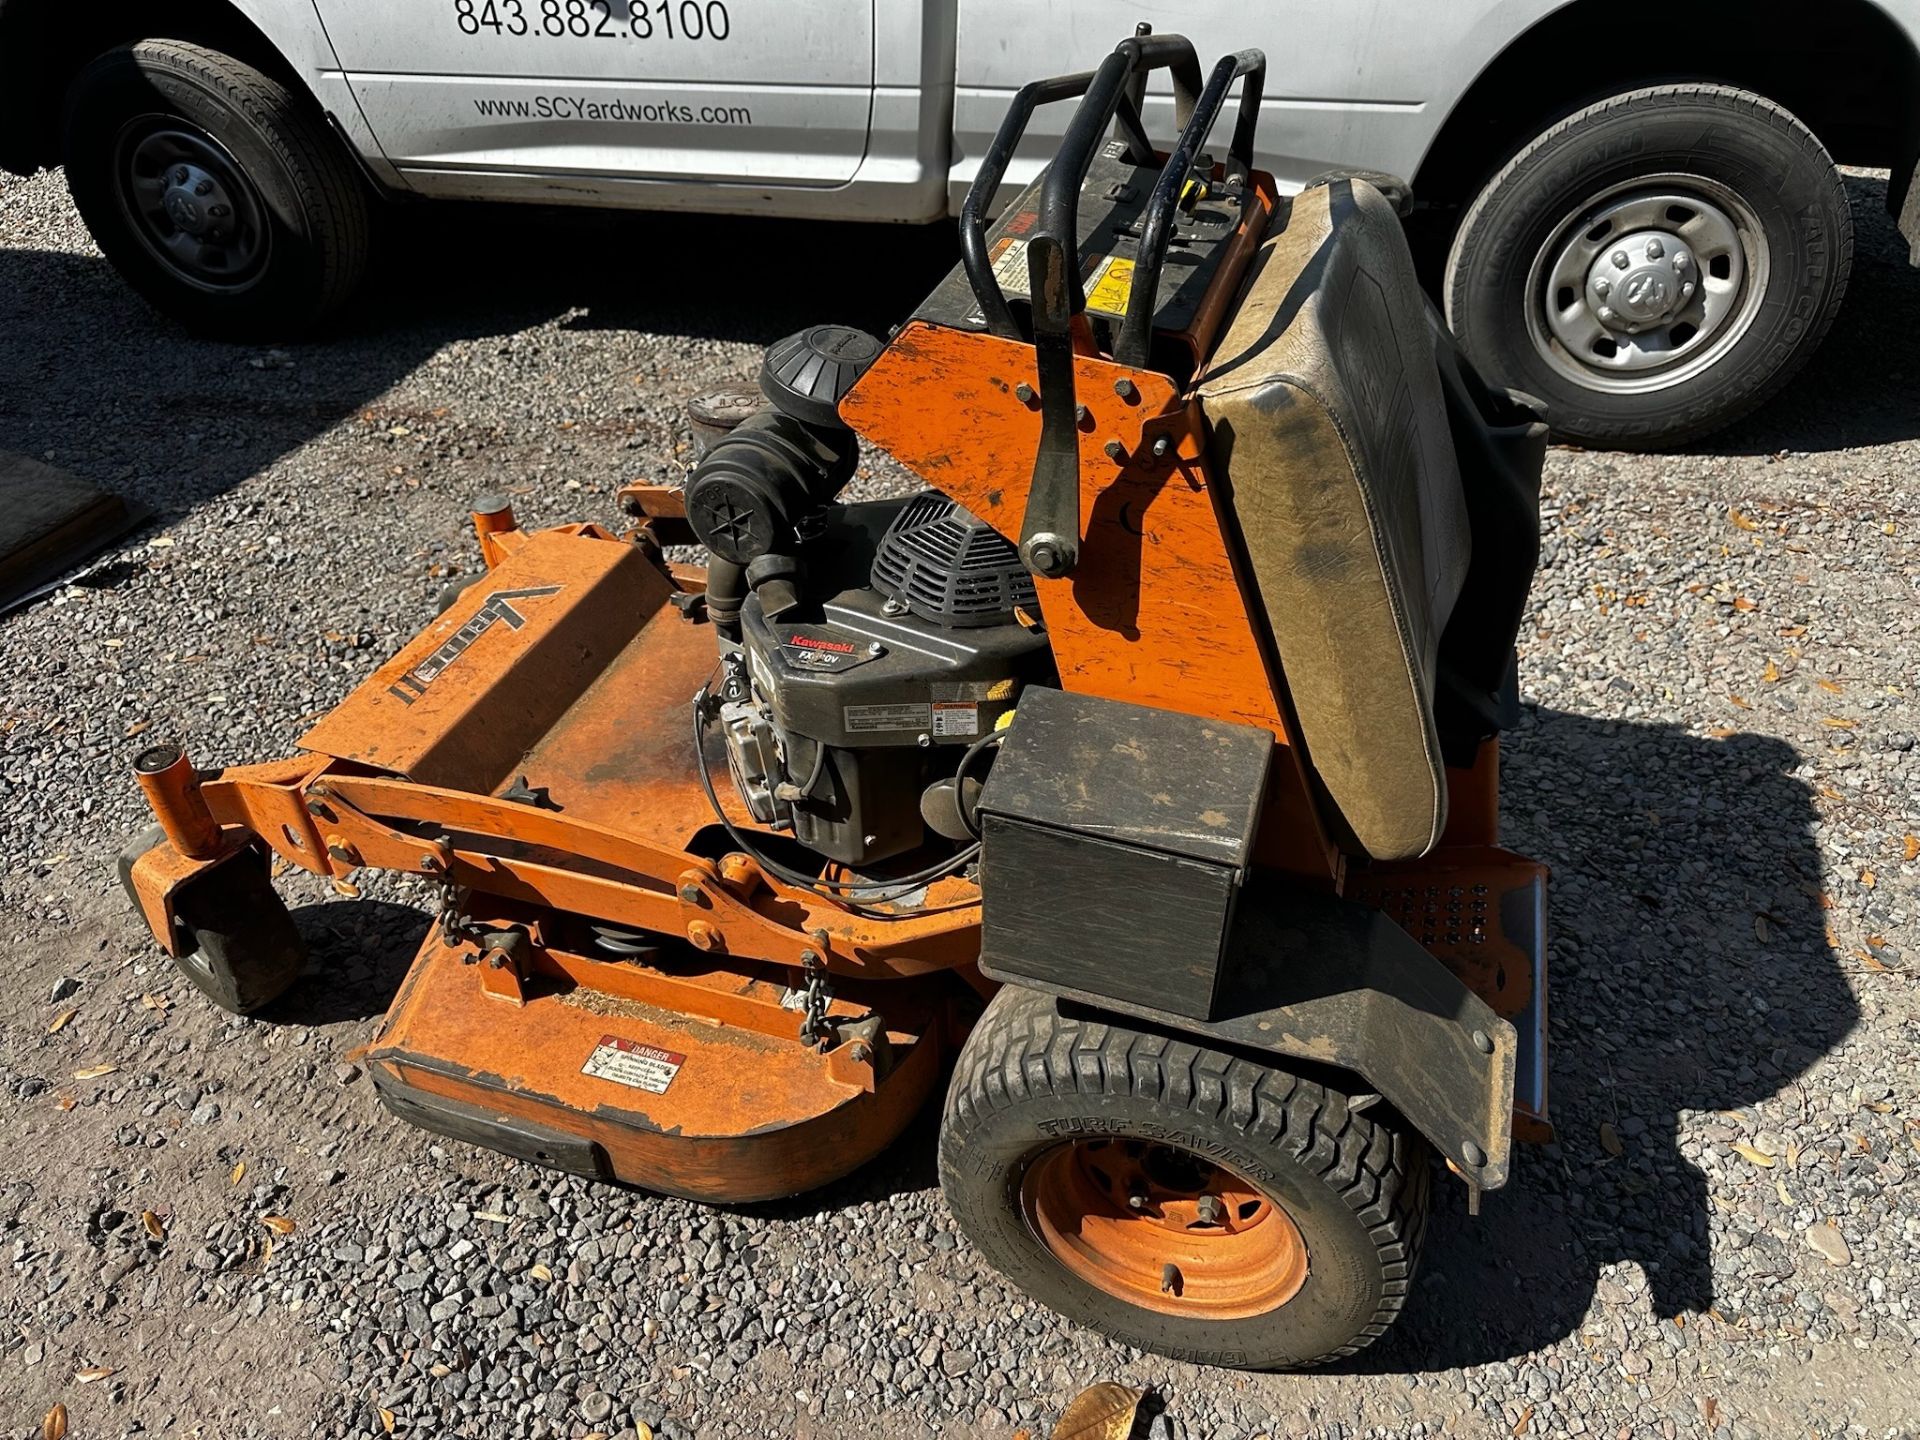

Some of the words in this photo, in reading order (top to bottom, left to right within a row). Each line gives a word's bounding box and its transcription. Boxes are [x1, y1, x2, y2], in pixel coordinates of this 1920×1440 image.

[454, 0, 730, 41] 843.882.8100
[474, 95, 752, 124] www.SCYardworks.com
[790, 634, 855, 654] Kawasaki
[798, 650, 841, 664] FX0V
[631, 1045, 670, 1061] DANGER
[1037, 1116, 1132, 1137] TURF
[1082, 1320, 1248, 1367] CARLISL
